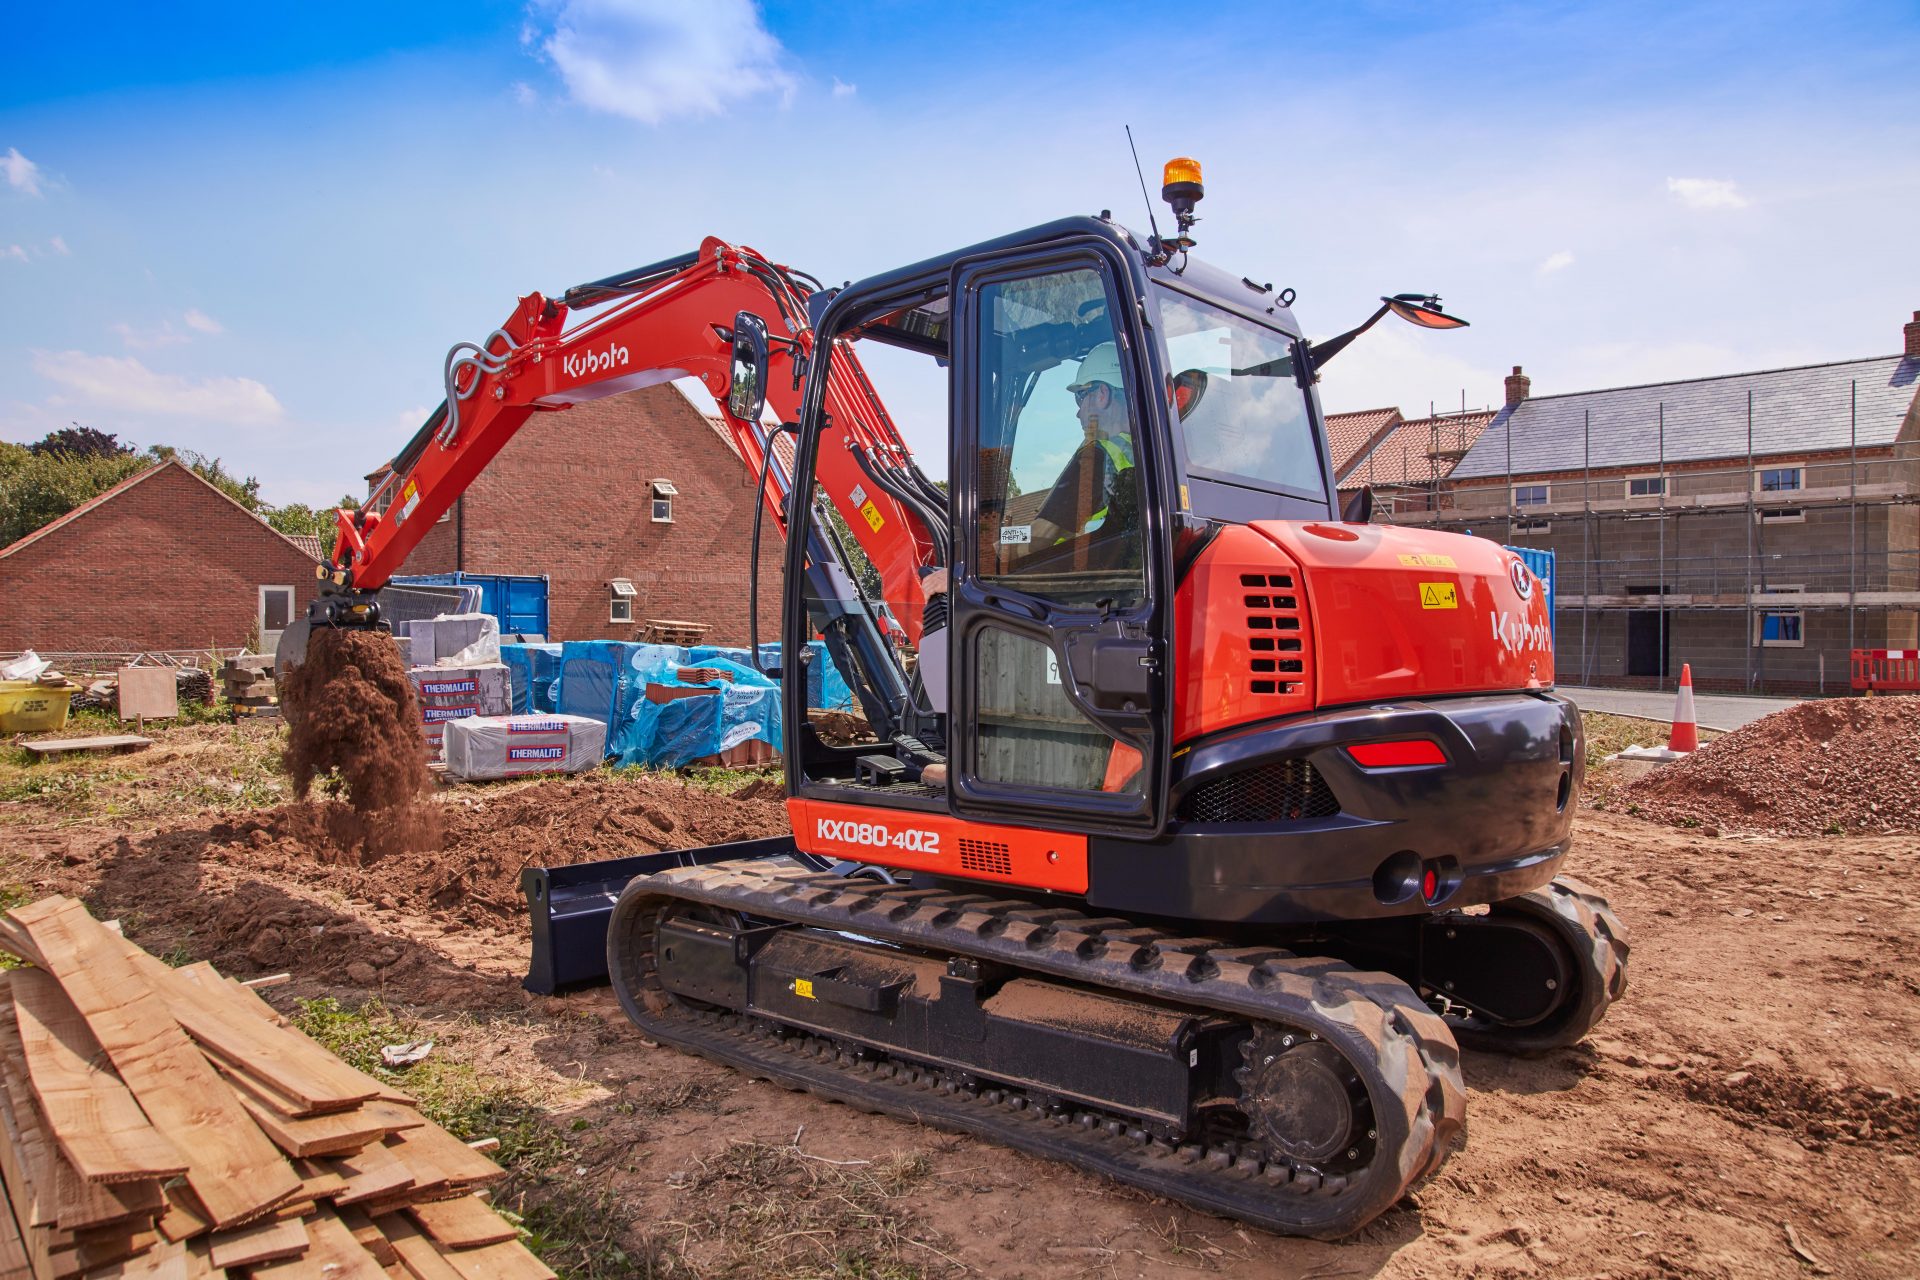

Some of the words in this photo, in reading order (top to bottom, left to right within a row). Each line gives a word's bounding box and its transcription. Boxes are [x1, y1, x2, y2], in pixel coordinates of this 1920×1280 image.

[564, 342, 629, 378] Kubota
[1490, 611, 1552, 653] Kubota
[424, 681, 476, 693] THERMALITE
[425, 707, 477, 718] THERMALITE
[510, 722, 564, 732] THERMALITE
[511, 747, 563, 759] THERMALITE
